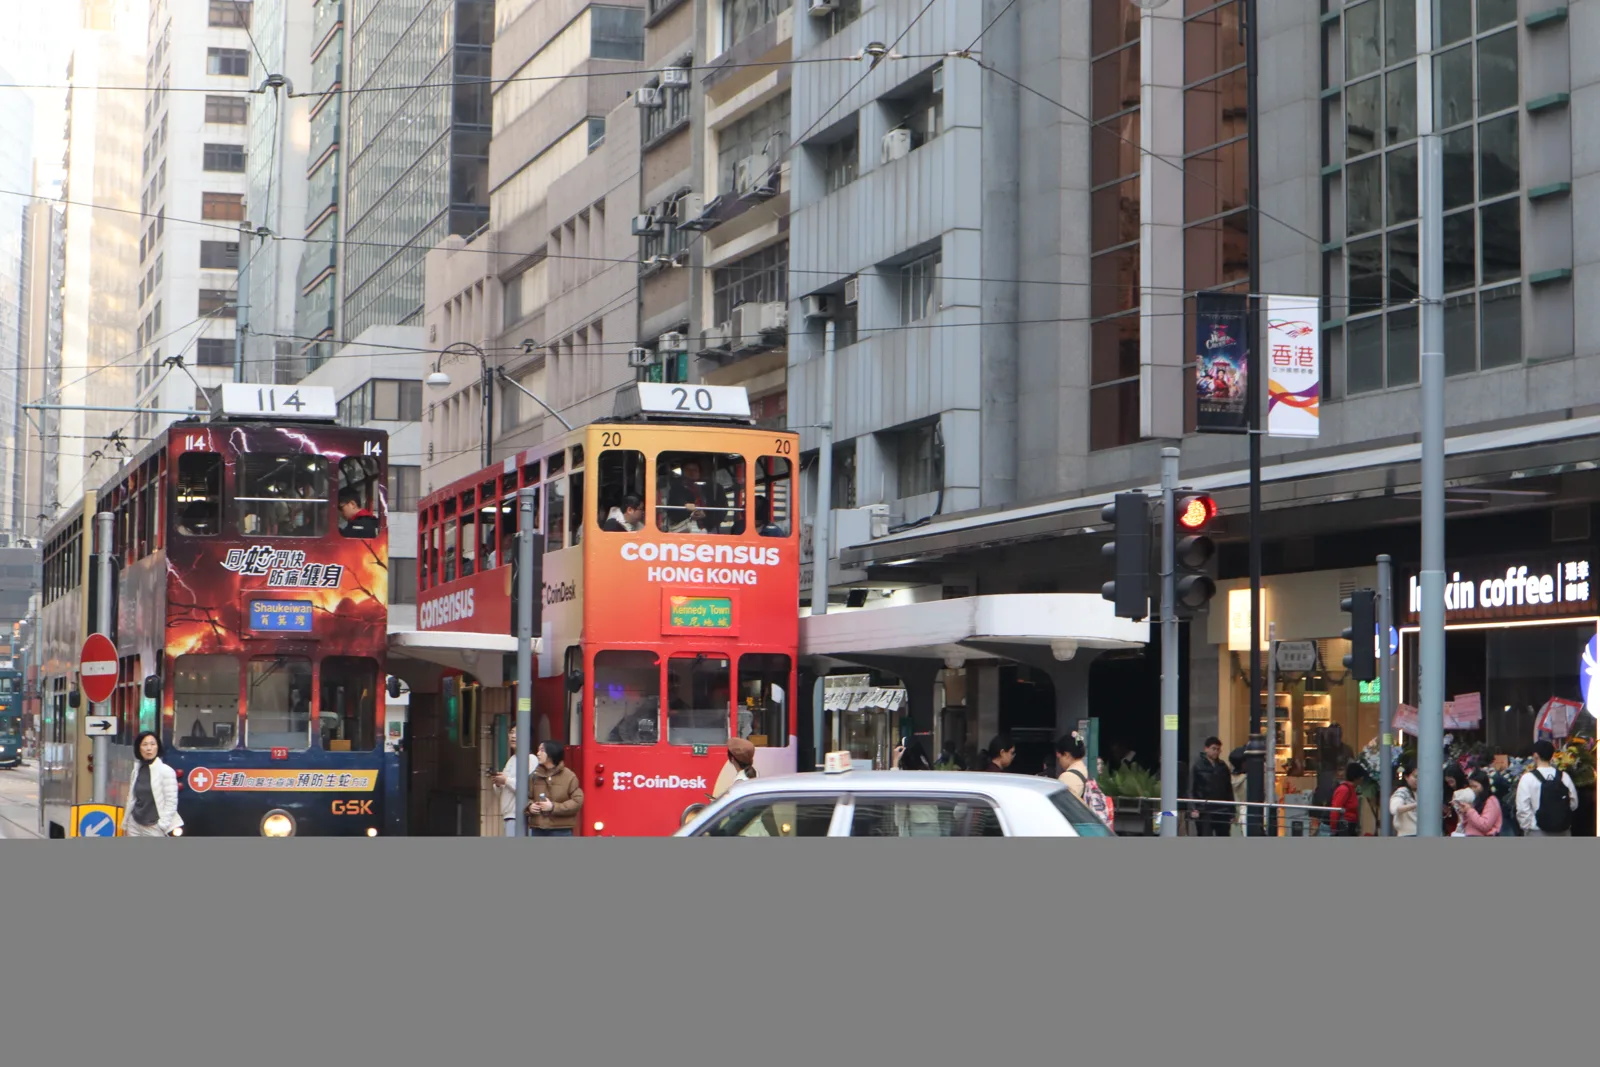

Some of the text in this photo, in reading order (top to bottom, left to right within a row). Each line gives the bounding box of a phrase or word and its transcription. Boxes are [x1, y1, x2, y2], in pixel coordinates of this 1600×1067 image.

[1272, 344, 1314, 367] 香港
[257, 388, 306, 412] 114
[671, 387, 713, 411] 20
[185, 435, 206, 450] 114
[602, 432, 621, 447] 20
[775, 439, 791, 454] 20
[363, 441, 382, 456] 114
[620, 542, 780, 566] consensus
[648, 567, 757, 585] HONG KONG
[546, 580, 577, 605] CoinDesk
[1409, 565, 1554, 613] lkin coffee
[254, 602, 313, 613] Shaukeiwan
[420, 587, 474, 629] consensus
[673, 604, 730, 617] Kennedy Town
[272, 749, 287, 757] 123
[693, 745, 708, 754] 132
[633, 774, 707, 789] CoinDesk
[331, 799, 373, 815] GSK
